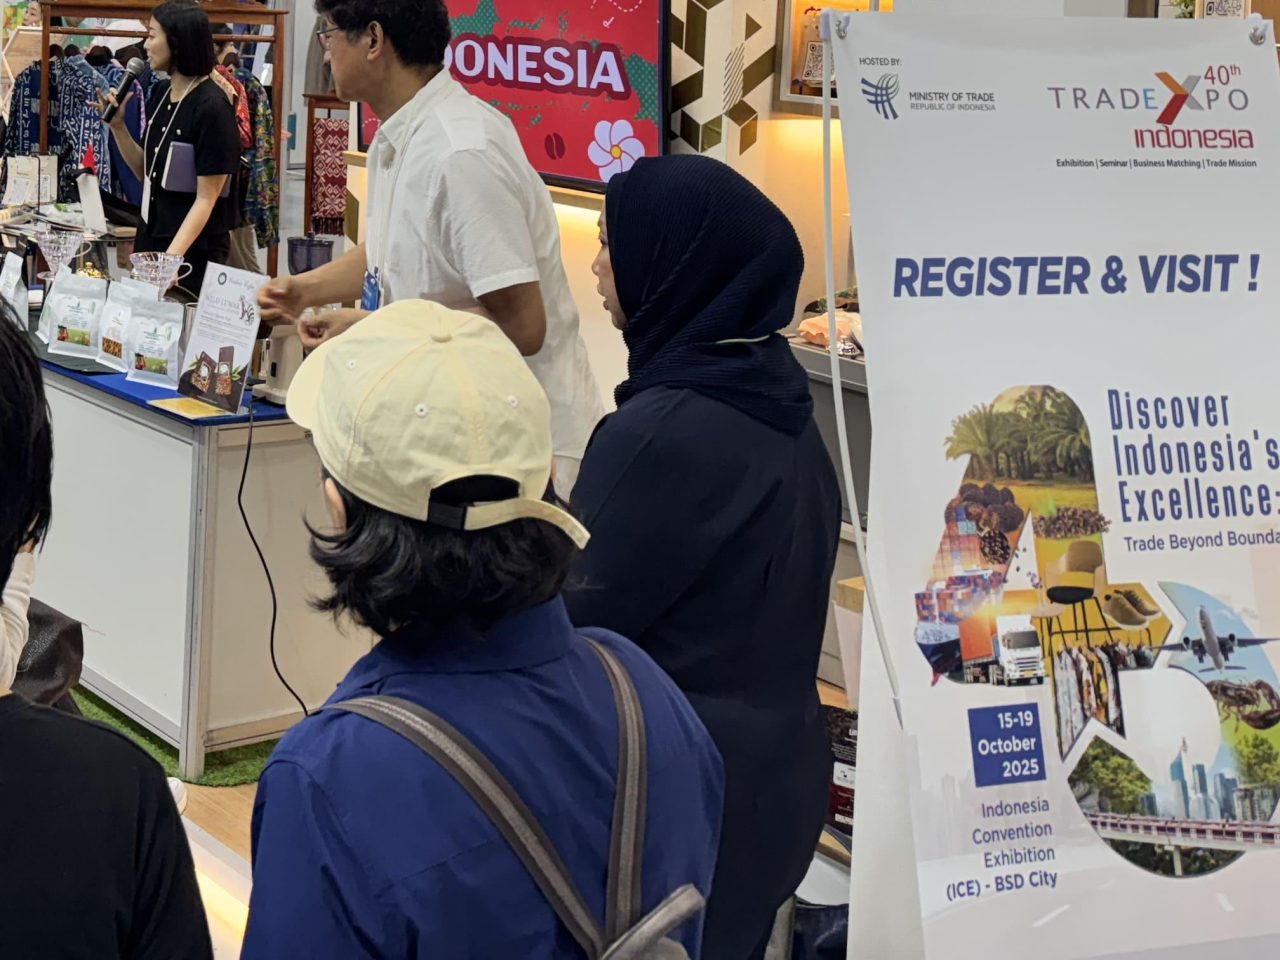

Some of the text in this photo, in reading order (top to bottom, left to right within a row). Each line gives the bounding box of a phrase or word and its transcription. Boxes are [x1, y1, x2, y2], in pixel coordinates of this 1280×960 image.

[445, 38, 625, 93] ONESIA
[859, 57, 889, 66] HOSTED
[1203, 64, 1241, 86] 40th
[909, 92, 995, 102] MINISTRY OF TRADE
[910, 103, 997, 112] REPUBLIC OF INDONESIA
[1056, 159, 1257, 169] Exhibition Seminar Business Matching Trade Mission
[893, 256, 1092, 298] REGISTER
[1101, 255, 1127, 294] &
[1139, 254, 1239, 294] VISIT
[1108, 389, 1229, 430] Discover
[1113, 429, 1280, 476] Indonesia's
[1124, 535, 1165, 552] Trade
[1169, 531, 1223, 552] Beyond
[997, 710, 1034, 729] 15-19
[978, 736, 1036, 755] October
[1002, 758, 1040, 778] 2025
[981, 796, 1050, 819] Indonesia
[972, 822, 1053, 845] Convention
[984, 847, 1056, 869] Exhibition
[946, 879, 982, 902] (ICE)
[994, 873, 1025, 892] BSD
[1028, 870, 1058, 888] City
